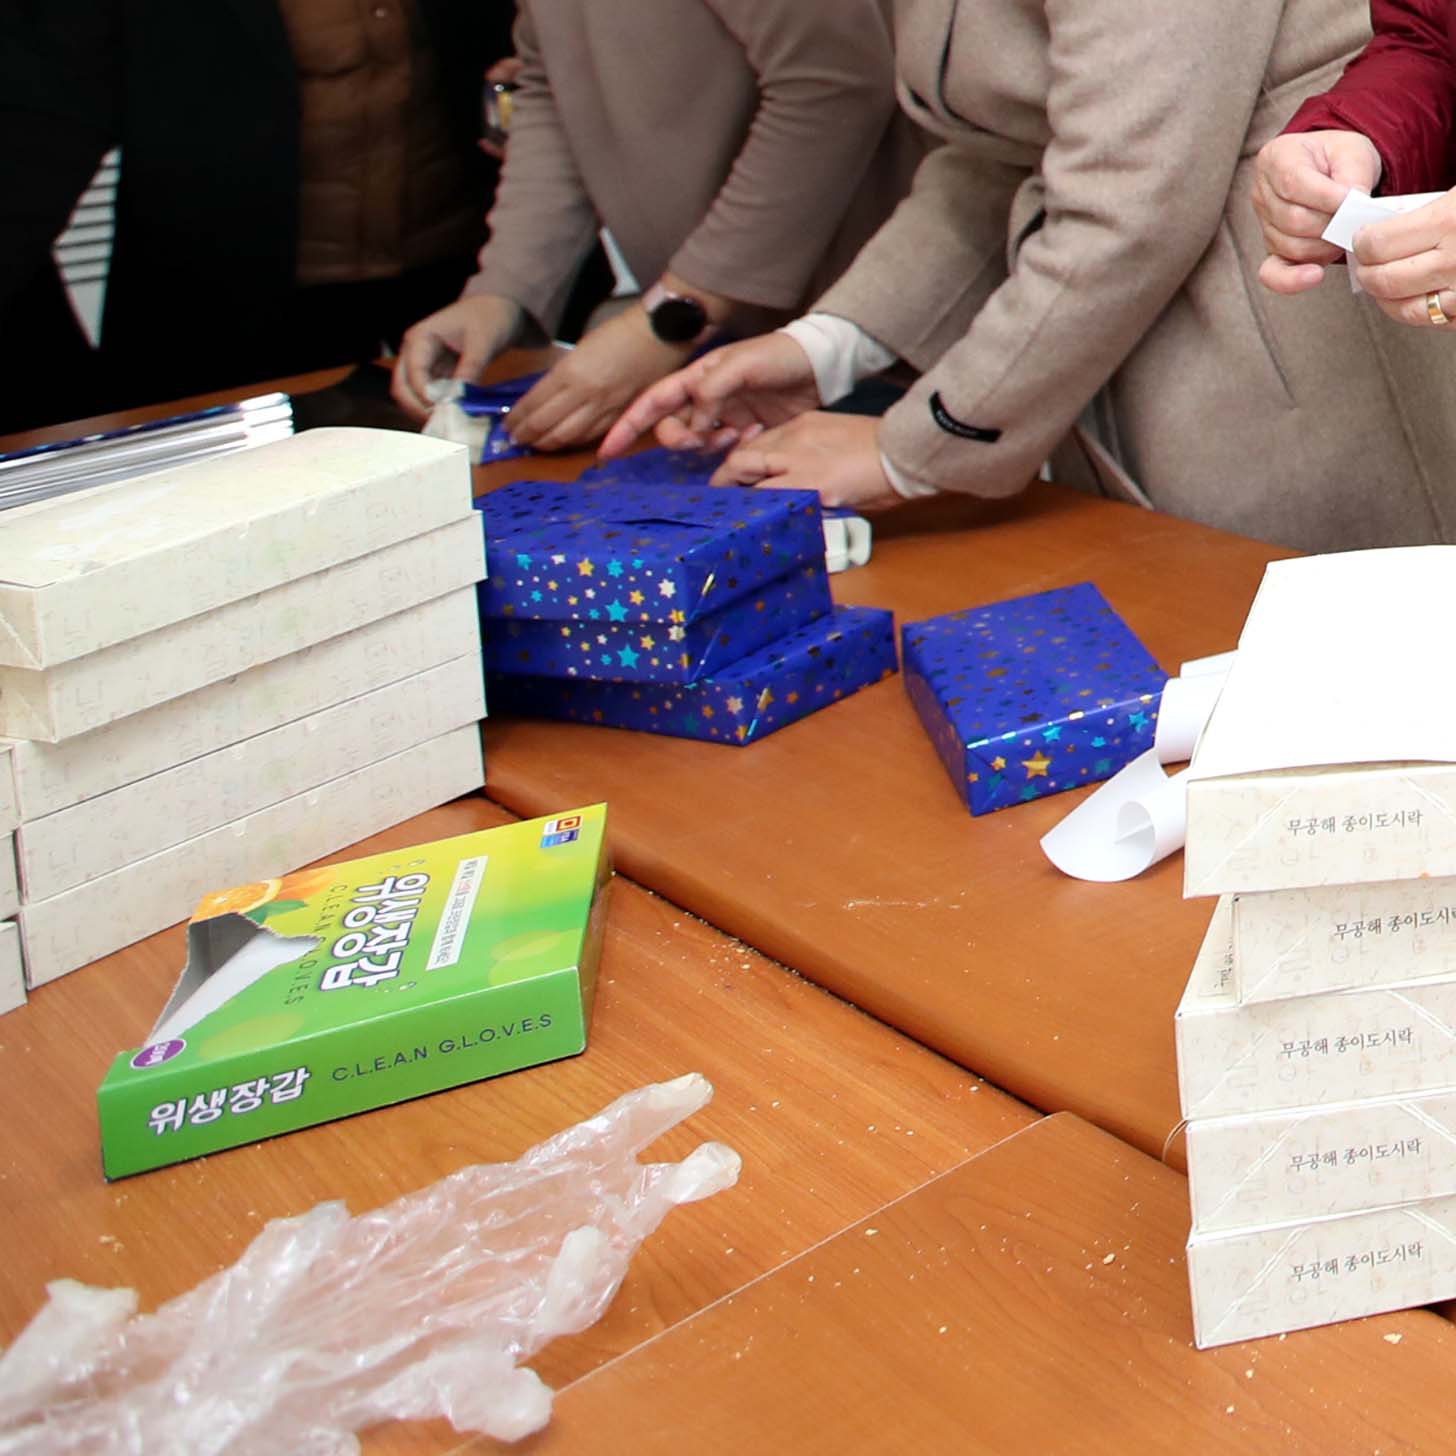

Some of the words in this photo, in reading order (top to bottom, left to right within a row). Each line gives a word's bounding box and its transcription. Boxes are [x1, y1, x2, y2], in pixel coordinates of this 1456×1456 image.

[1288, 815, 1337, 836] 무공해
[1342, 808, 1424, 833] 종이도시락
[319, 872, 431, 992] 위생장갑
[1334, 917, 1383, 941] 무공해
[332, 1043, 429, 1082] C.L.E.A.N
[438, 1013, 553, 1054] G.L.O.V.E.S
[1280, 1037, 1329, 1059] 무공해
[1334, 1027, 1414, 1054] 종이도시락
[147, 1066, 312, 1136] 위생장갑
[1290, 1150, 1338, 1173] 무공해
[1343, 1137, 1423, 1165] 종이도시락
[1291, 1257, 1340, 1283] 무공해
[1344, 1241, 1424, 1273] 종이도시락
